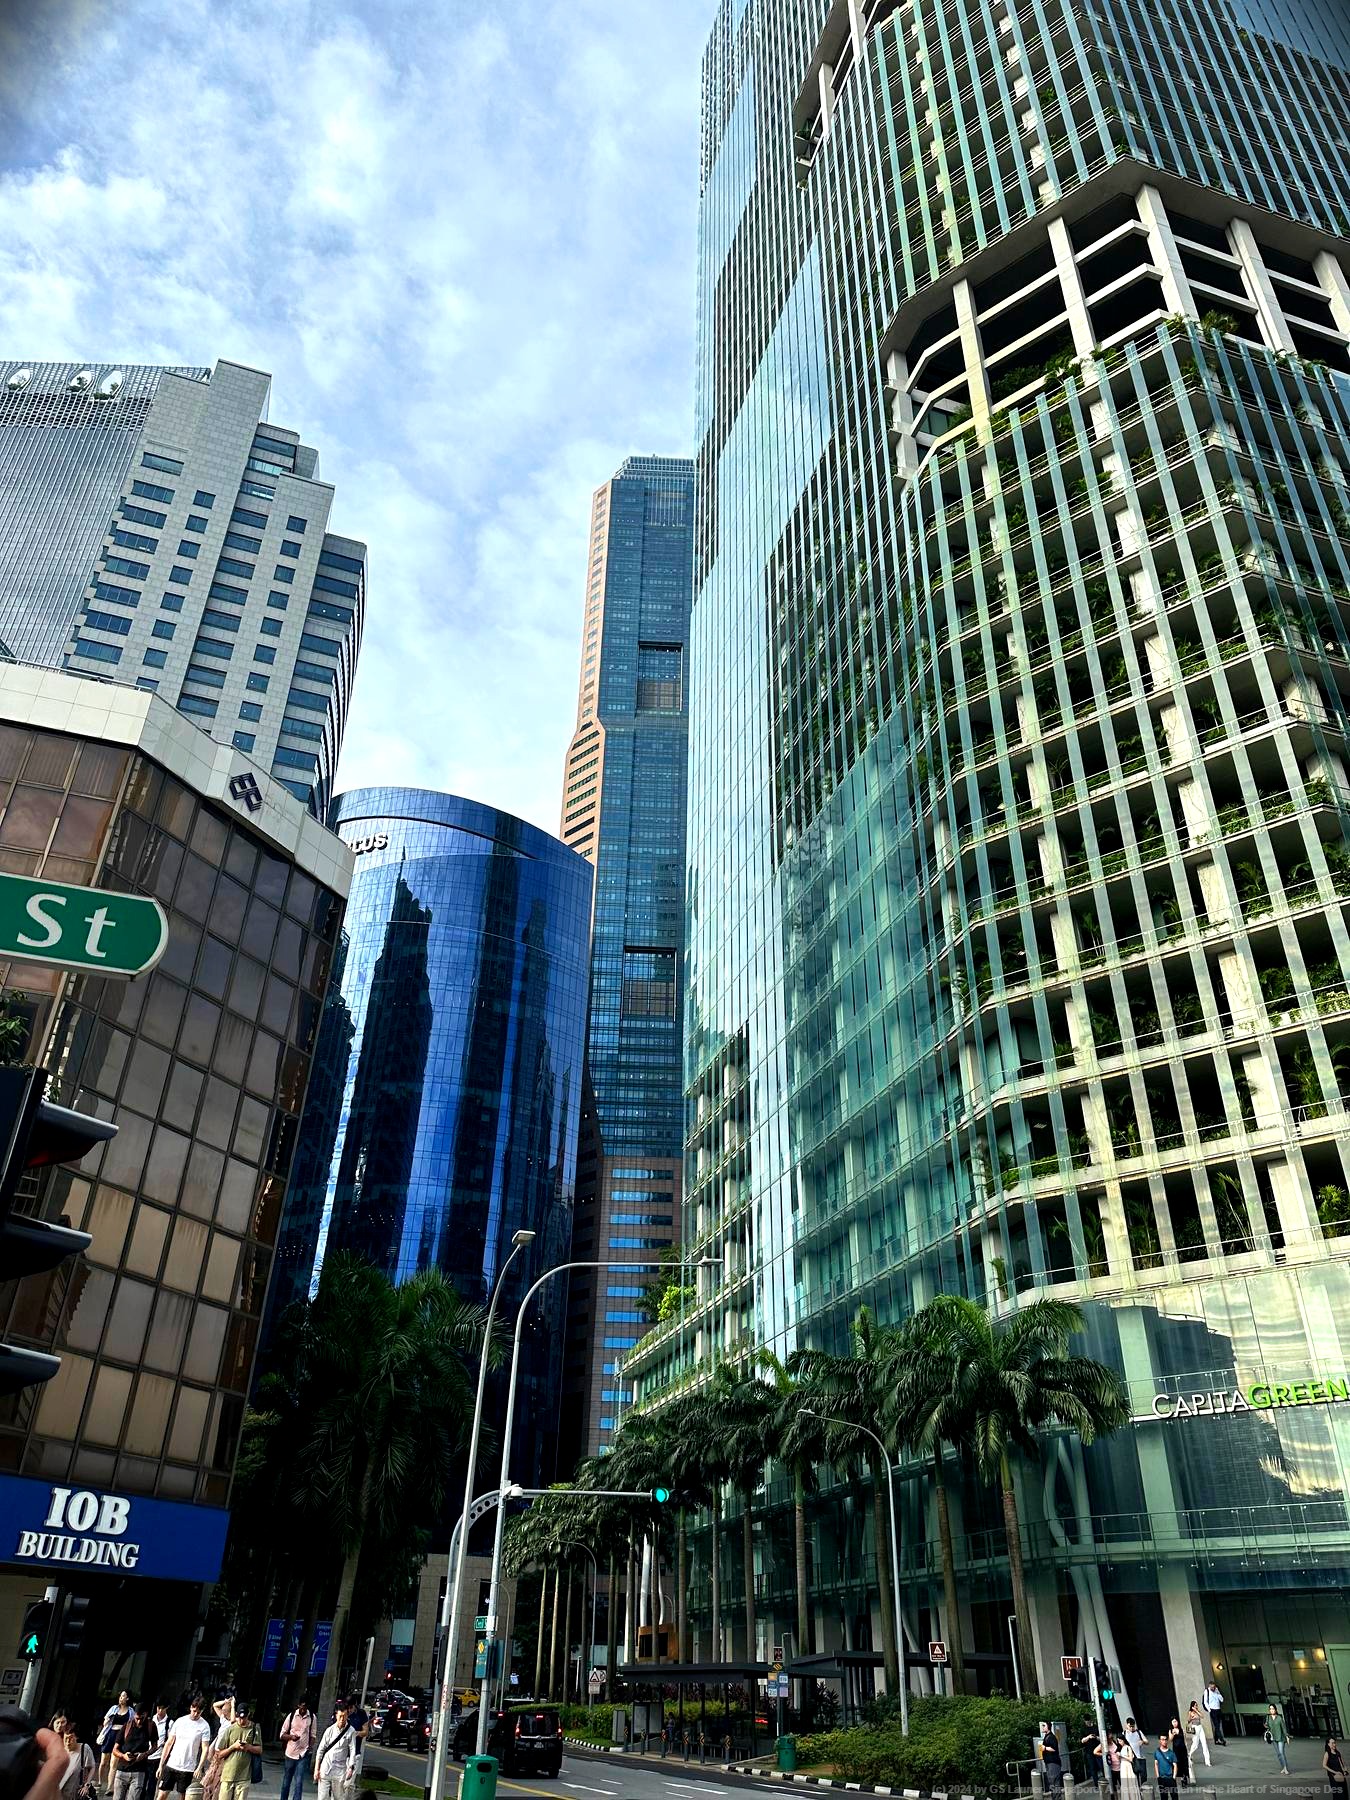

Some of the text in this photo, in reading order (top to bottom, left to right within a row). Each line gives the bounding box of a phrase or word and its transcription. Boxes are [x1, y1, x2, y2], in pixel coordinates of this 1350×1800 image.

[17, 893, 116, 958] St
[44, 1487, 131, 1536] IOB
[15, 1530, 140, 1568] BUILDING
